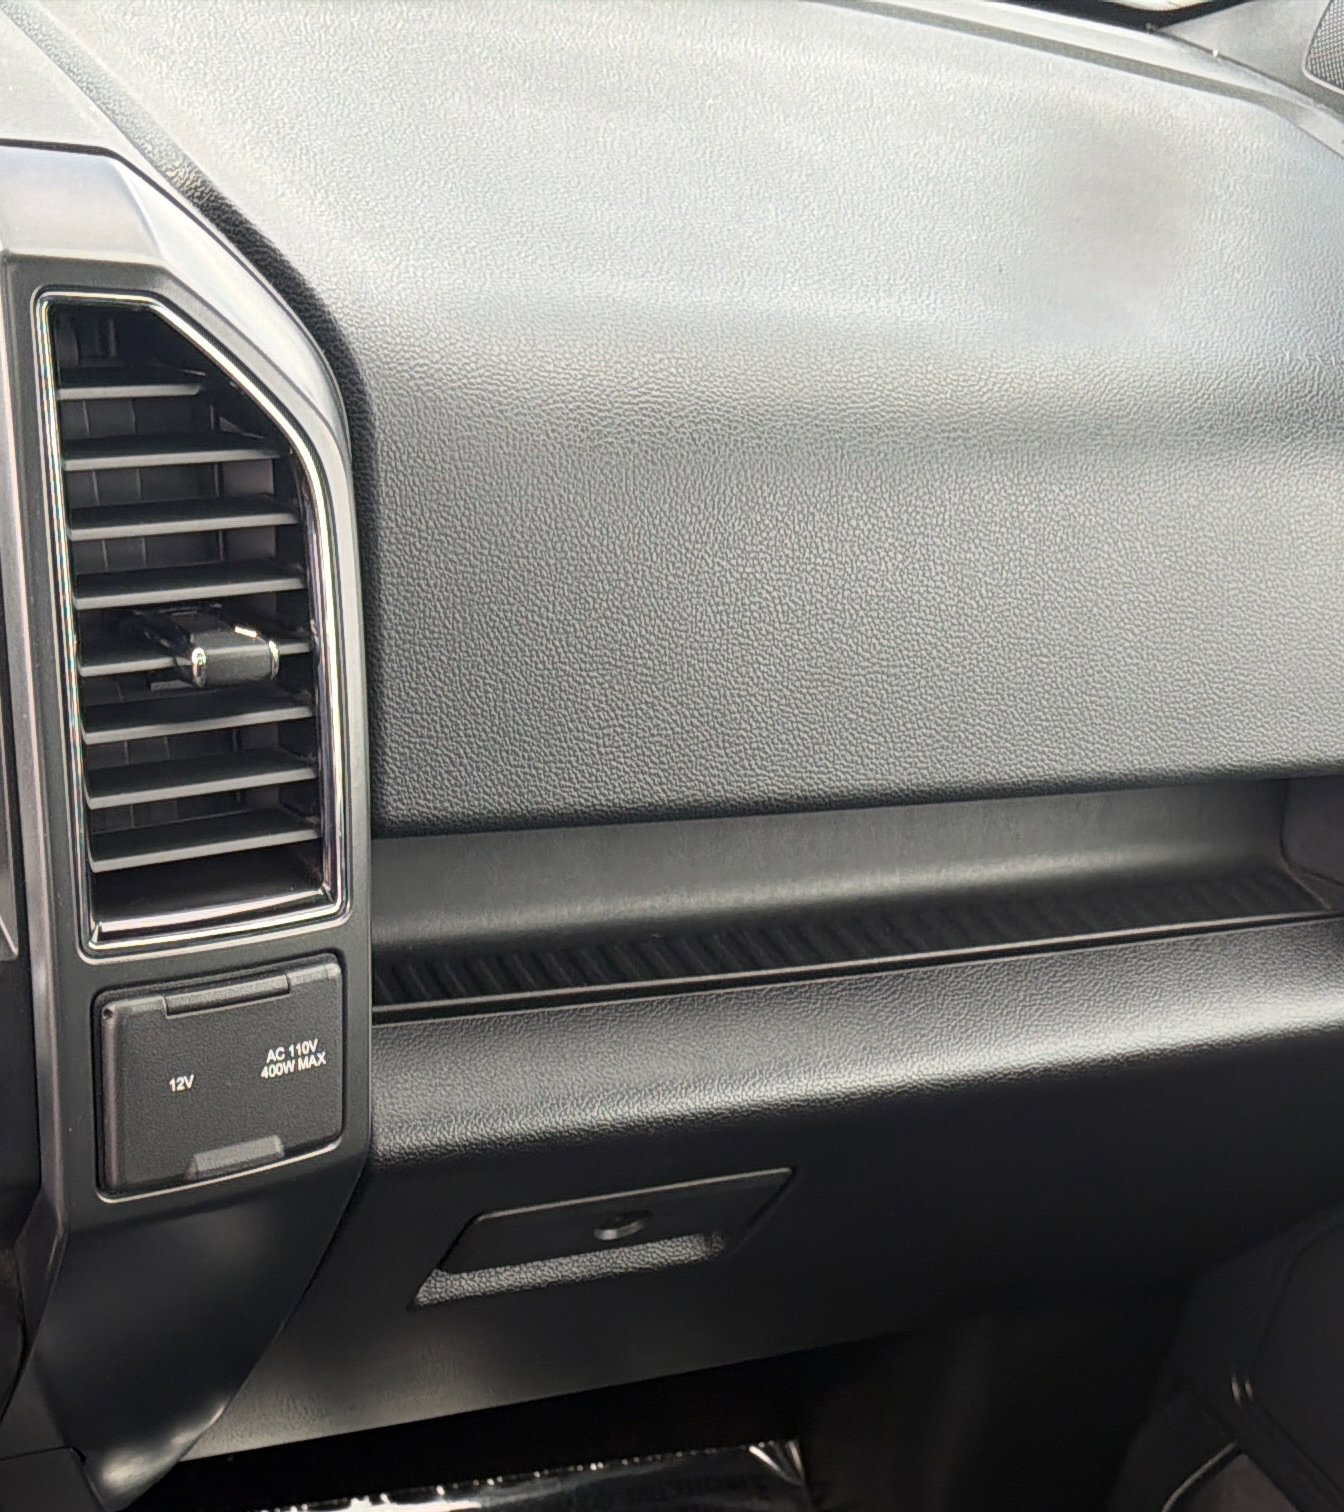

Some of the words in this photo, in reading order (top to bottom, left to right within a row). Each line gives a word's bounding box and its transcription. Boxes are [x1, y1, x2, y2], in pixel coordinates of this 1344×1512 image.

[266, 1049, 285, 1063] AC
[288, 1038, 318, 1058] 110V
[260, 1061, 295, 1079] 400W
[298, 1052, 327, 1072] MAX
[169, 1074, 195, 1092] 12V
